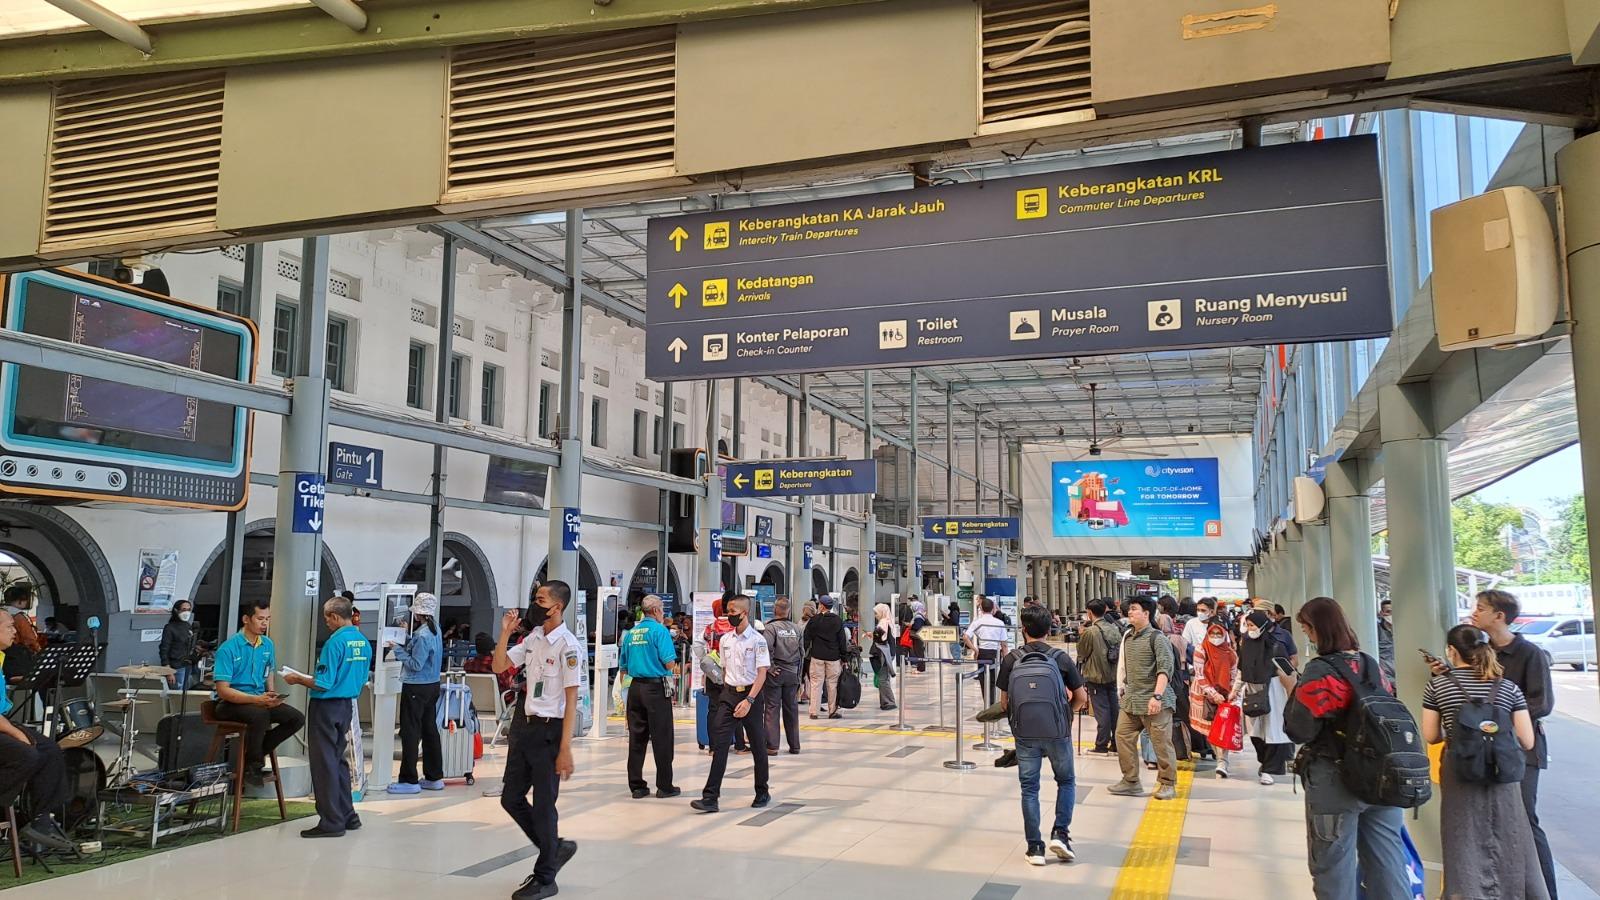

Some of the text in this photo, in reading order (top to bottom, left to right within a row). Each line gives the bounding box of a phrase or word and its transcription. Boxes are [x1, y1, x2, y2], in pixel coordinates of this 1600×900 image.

[1058, 168, 1223, 199] Keberangkatan KRL
[1058, 191, 1205, 214] Commuter Line Departures
[739, 199, 945, 231] Keberangkatan KA Jarak Jauh
[739, 227, 859, 246] Intercity Train Departures
[737, 274, 814, 290] Kedatangan
[737, 291, 772, 302] Arrivals
[1195, 287, 1348, 313] Ruang Menyusui
[1051, 306, 1107, 322] Musala
[1196, 312, 1273, 326] Nursery Room
[917, 317, 958, 331] Toilet
[1051, 323, 1120, 337] Prayer Room
[736, 327, 849, 344] Konter Pelaporan
[917, 335, 963, 346] Restroom
[736, 344, 813, 357] Check-in Counter
[336, 447, 362, 465] Pintu
[335, 467, 353, 480] Gate
[365, 452, 378, 484] 1
[780, 468, 852, 479] Keberangkatan
[1162, 467, 1194, 475] cityvision
[780, 482, 812, 490] Departures
[962, 521, 1009, 529] Keberangkatan
